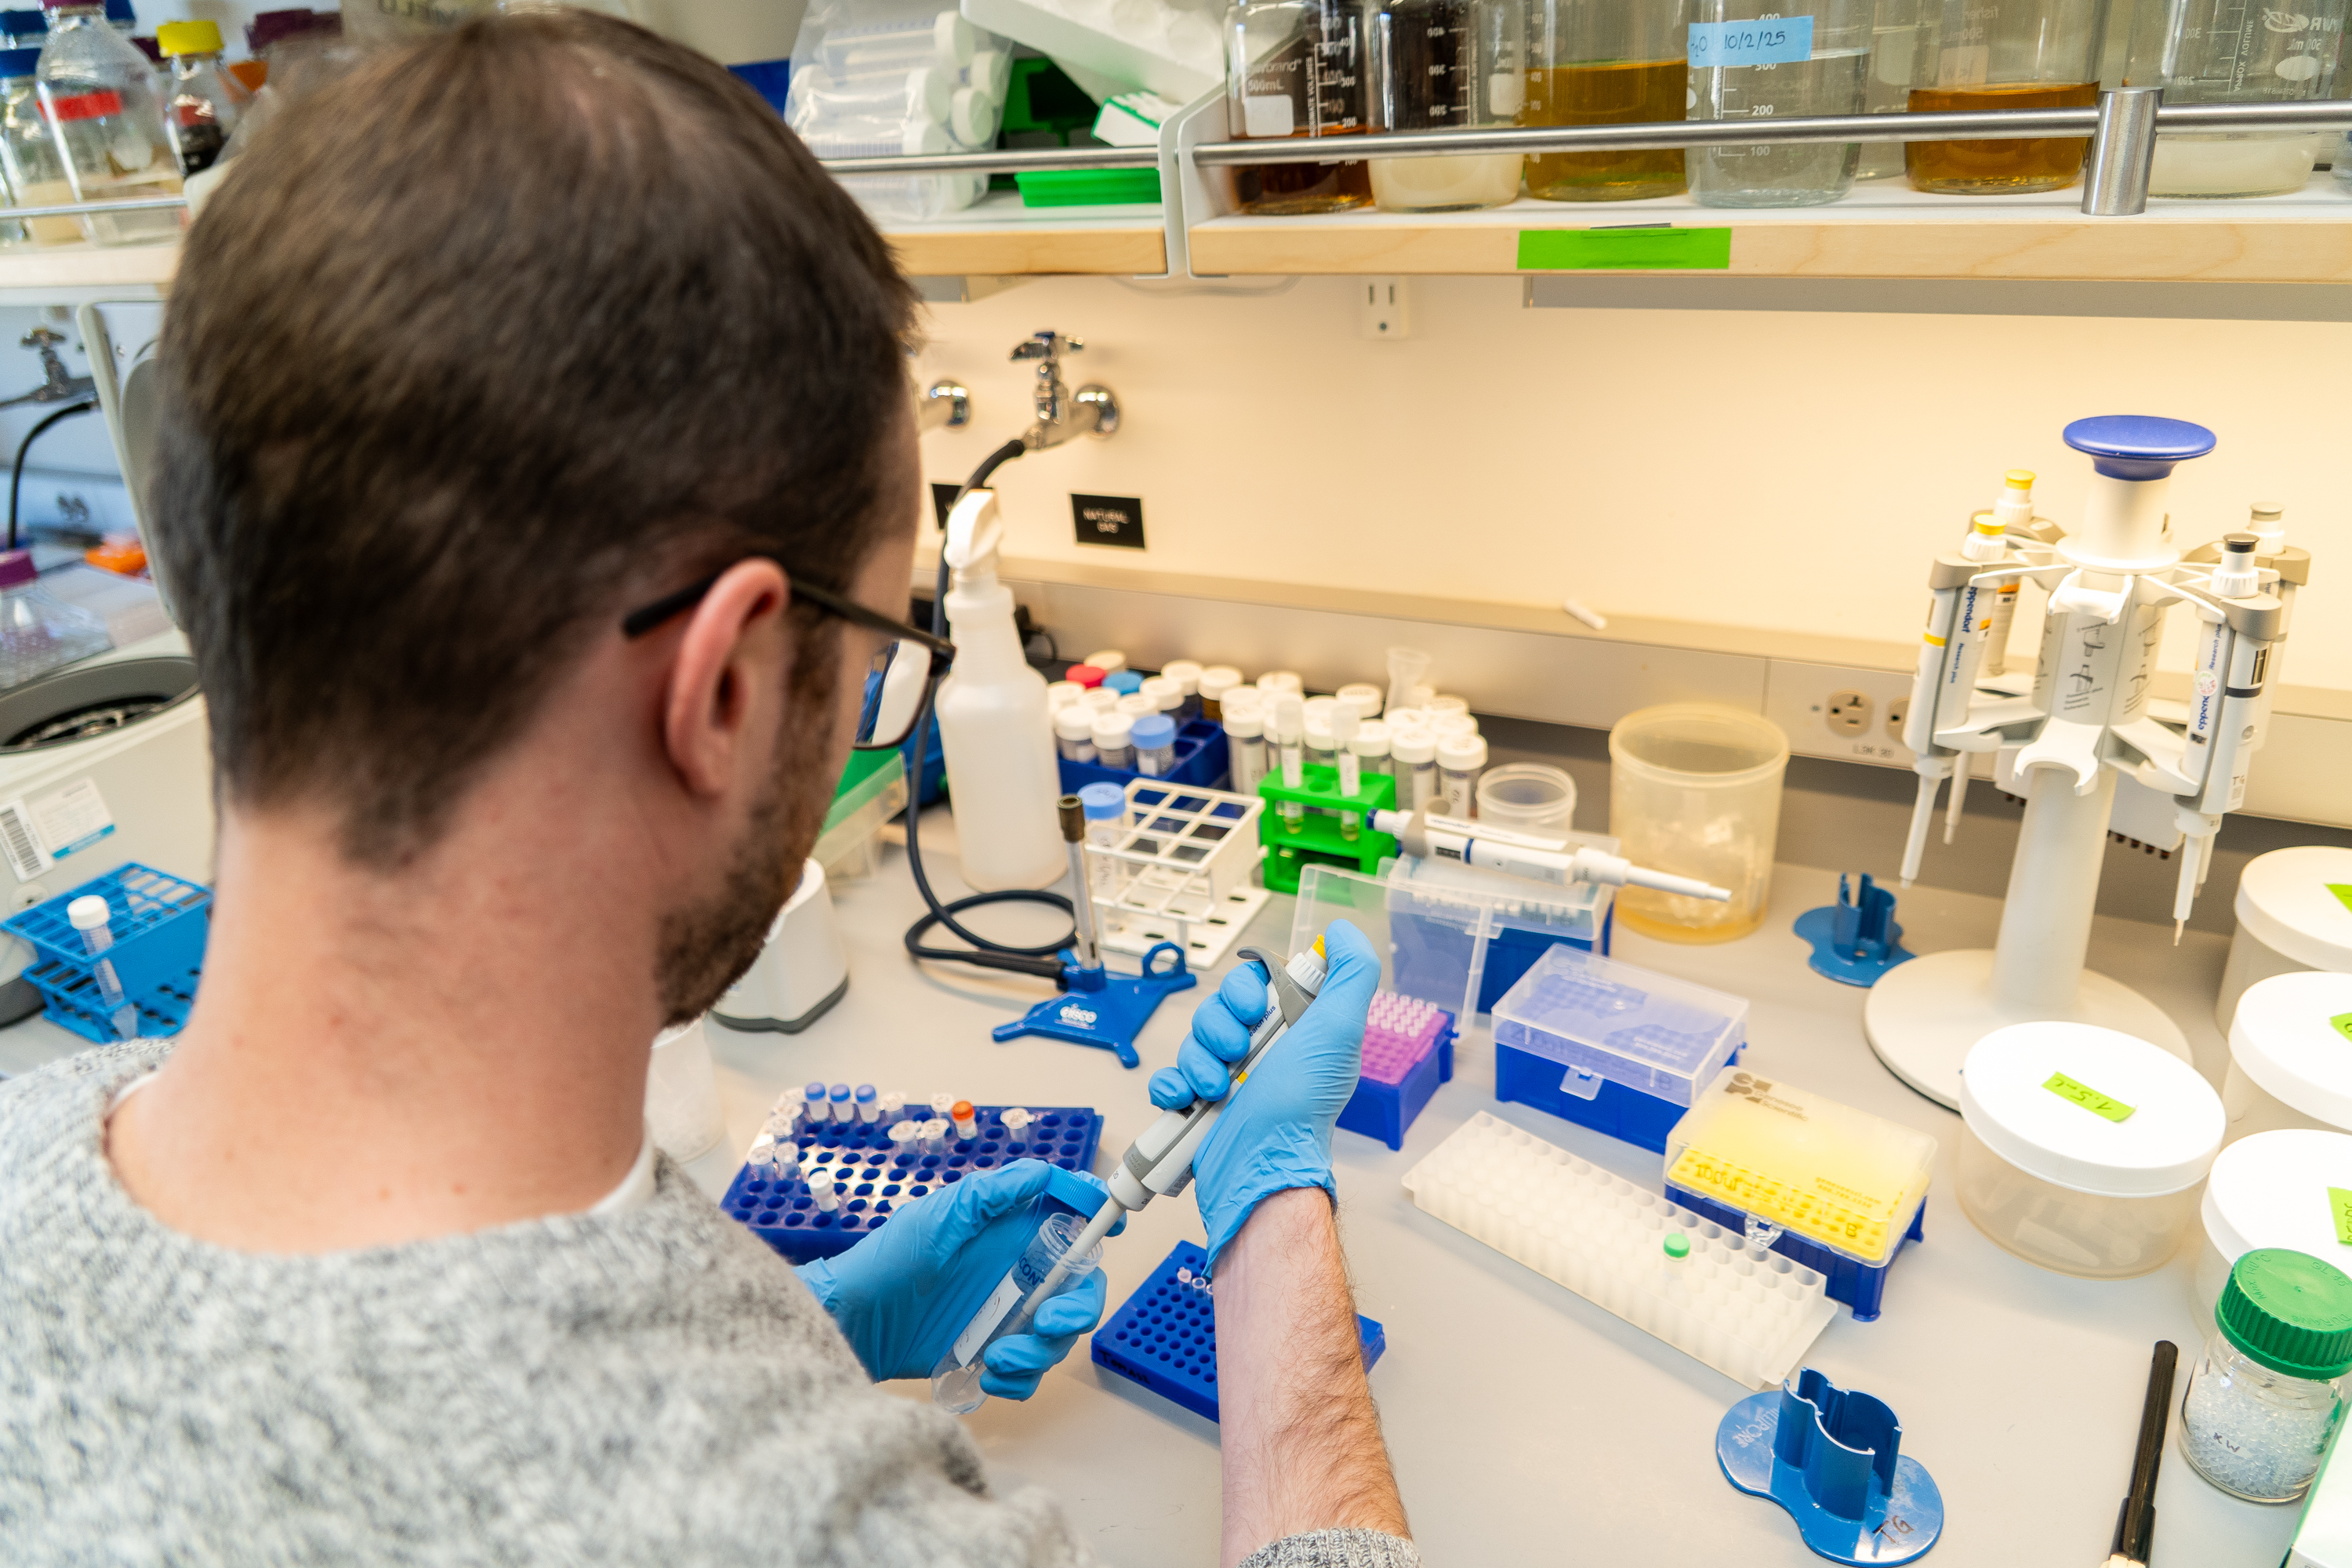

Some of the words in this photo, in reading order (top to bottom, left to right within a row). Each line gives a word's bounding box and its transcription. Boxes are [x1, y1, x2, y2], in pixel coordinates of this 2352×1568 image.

[1723, 31, 1786, 51] 10/2/25
[1751, 104, 1774, 116] 200
[1750, 145, 1771, 157] 100
[1249, 1018, 1264, 1037] earch
[1264, 1005, 1276, 1021] plus
[1755, 1091, 1803, 1111] Genesee
[1846, 1221, 1857, 1238] B
[2311, 1261, 2328, 1275] GL
[1872, 1515, 1915, 1544] TG
